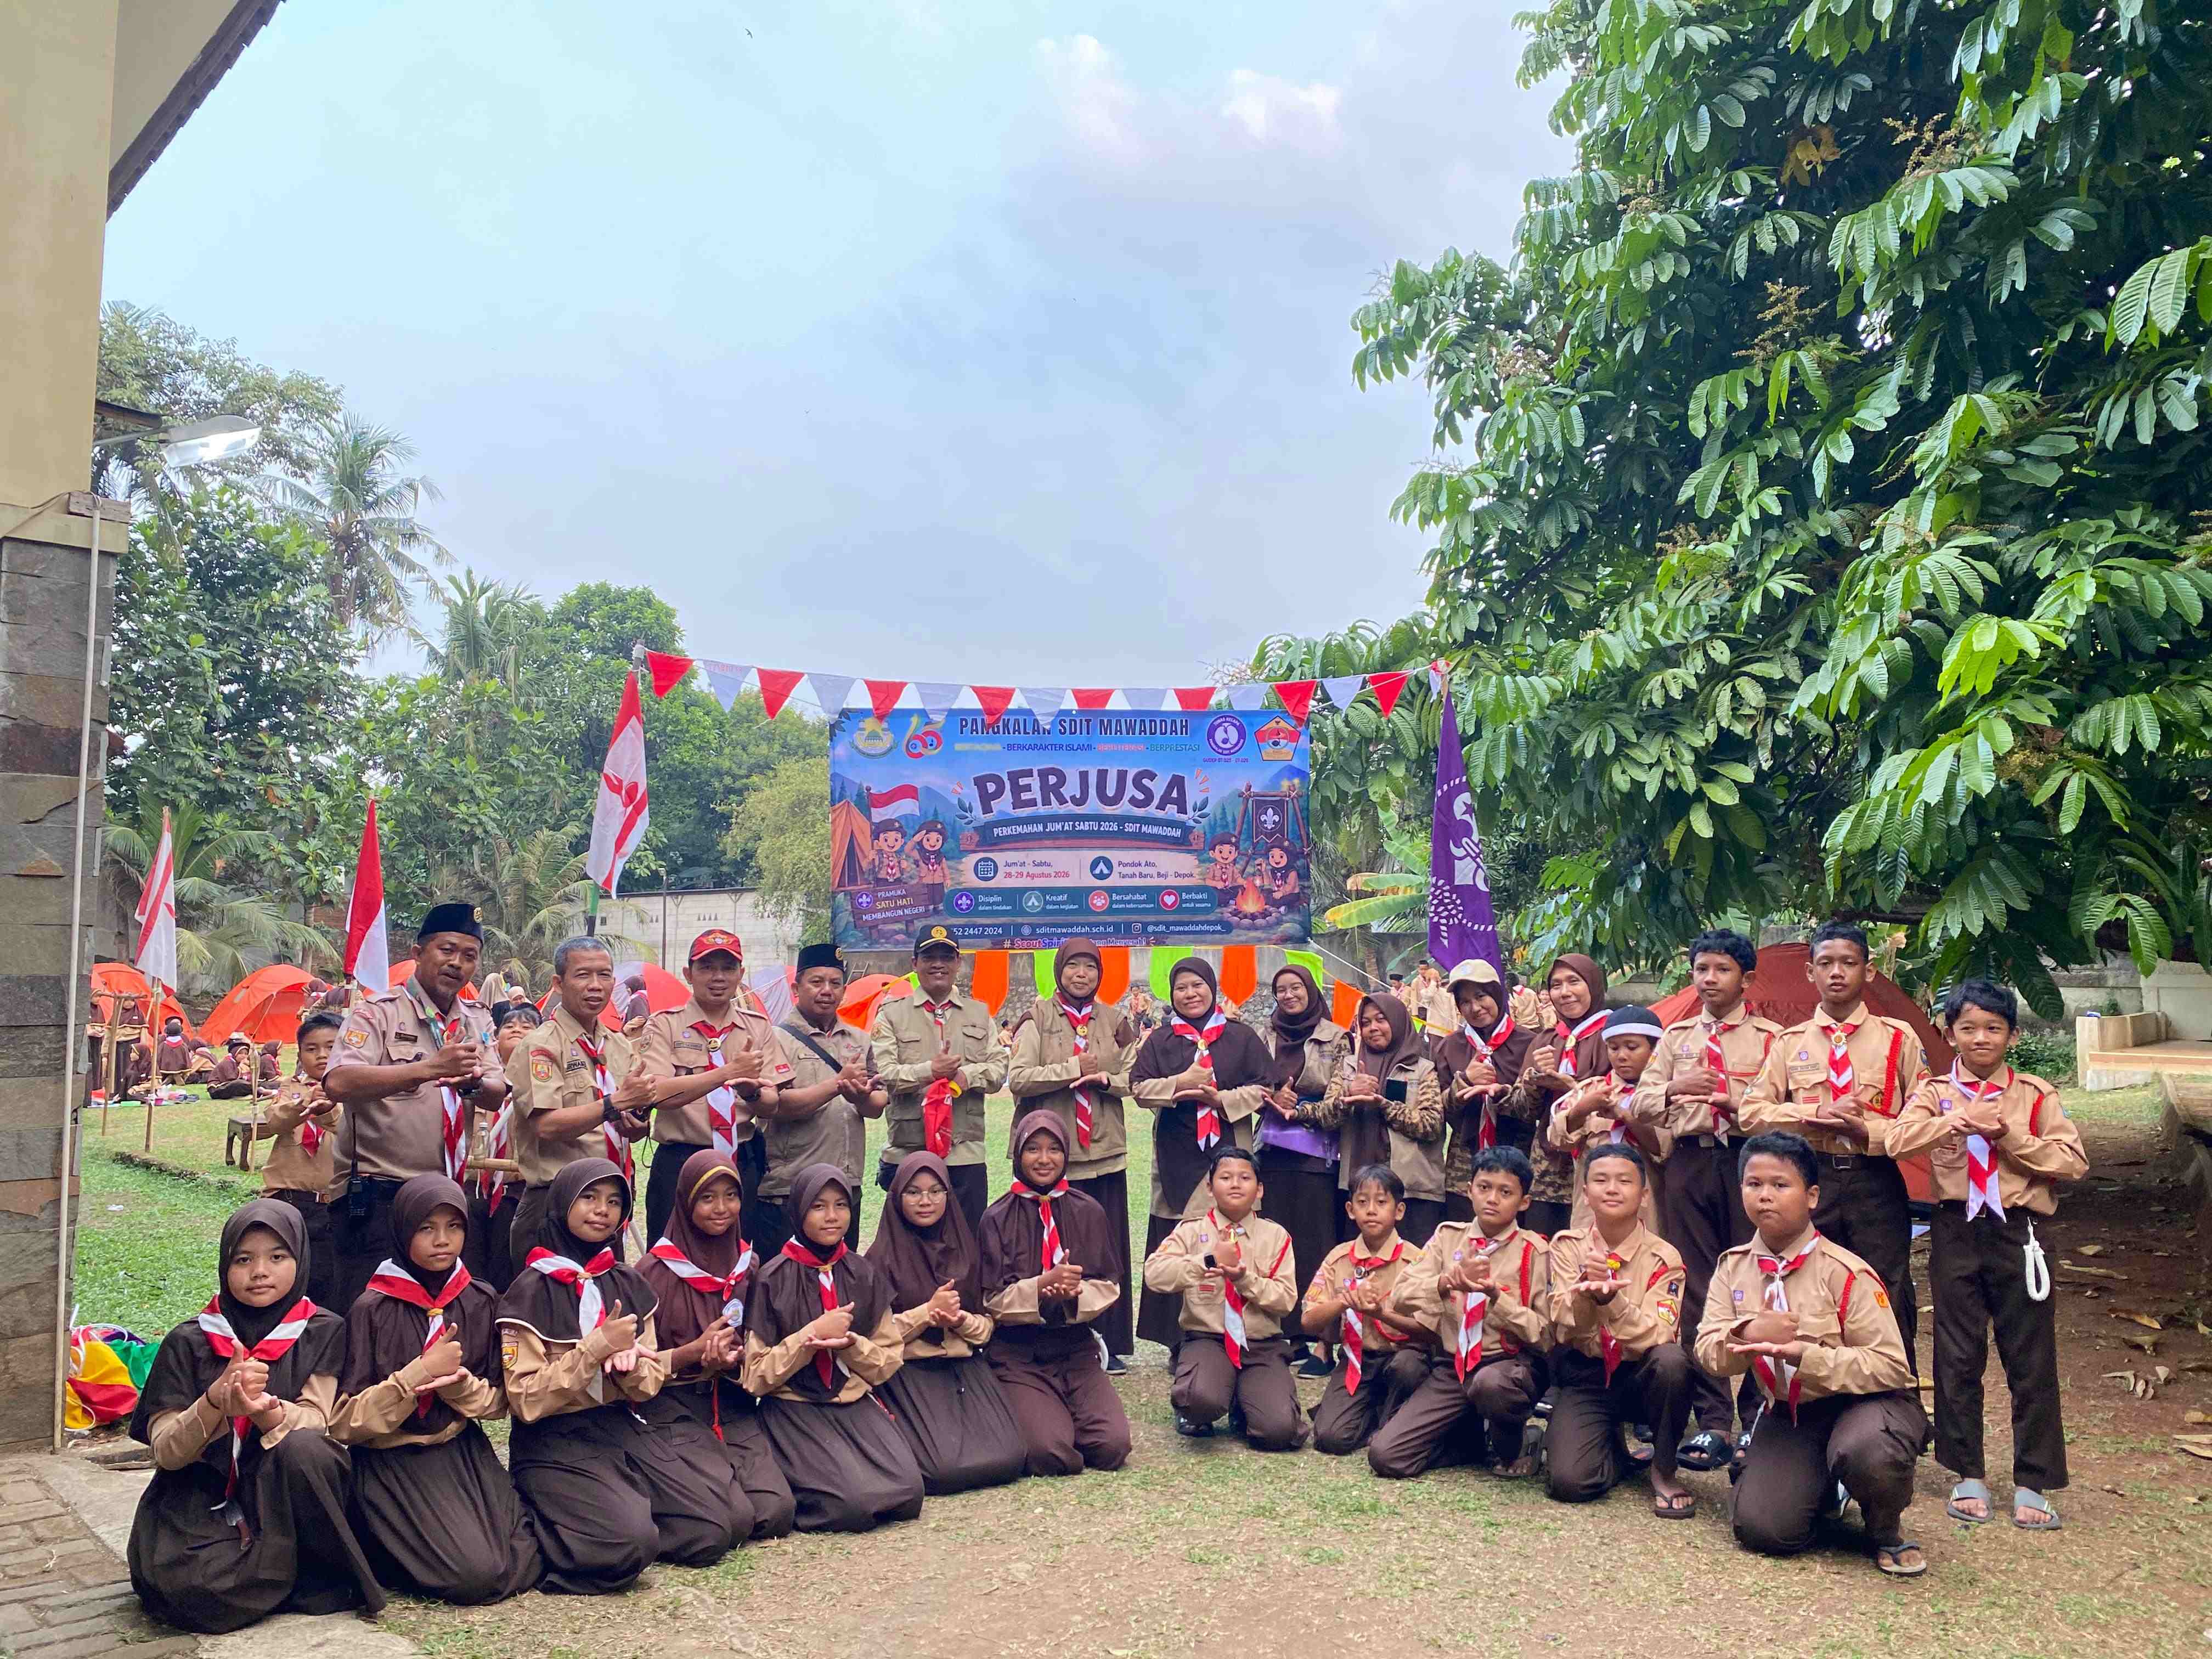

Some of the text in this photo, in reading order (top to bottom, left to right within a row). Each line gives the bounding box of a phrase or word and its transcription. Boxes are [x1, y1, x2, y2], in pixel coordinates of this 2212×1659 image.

[1059, 718, 1092, 735] SDIT
[1099, 718, 1189, 736] MAWADDAH
[1150, 743, 1200, 752] BERPRESTASI
[973, 767, 1188, 816] PERJUSA
[993, 823, 1043, 837] PERKEMAHAN
[1045, 821, 1074, 832] JUM'AT
[1075, 821, 1098, 831] SABTU
[1100, 822, 1118, 831] 2026
[1124, 823, 1142, 833] SDIT
[1142, 825, 1182, 838] MAWADDAH
[1031, 860, 1053, 868] Sabtu,
[1026, 871, 1052, 880] Agustus
[1156, 871, 1169, 880] Beji
[878, 889, 906, 899] PRAMUKA
[1182, 891, 1207, 900] Berbakti
[876, 898, 913, 909] SATU HATI
[978, 895, 1002, 904] Disiplin
[862, 906, 925, 921] MEMBANGUN NEGERI
[984, 927, 1003, 935] 2024
[1035, 925, 1114, 933] sditmawaddah.sch.id
